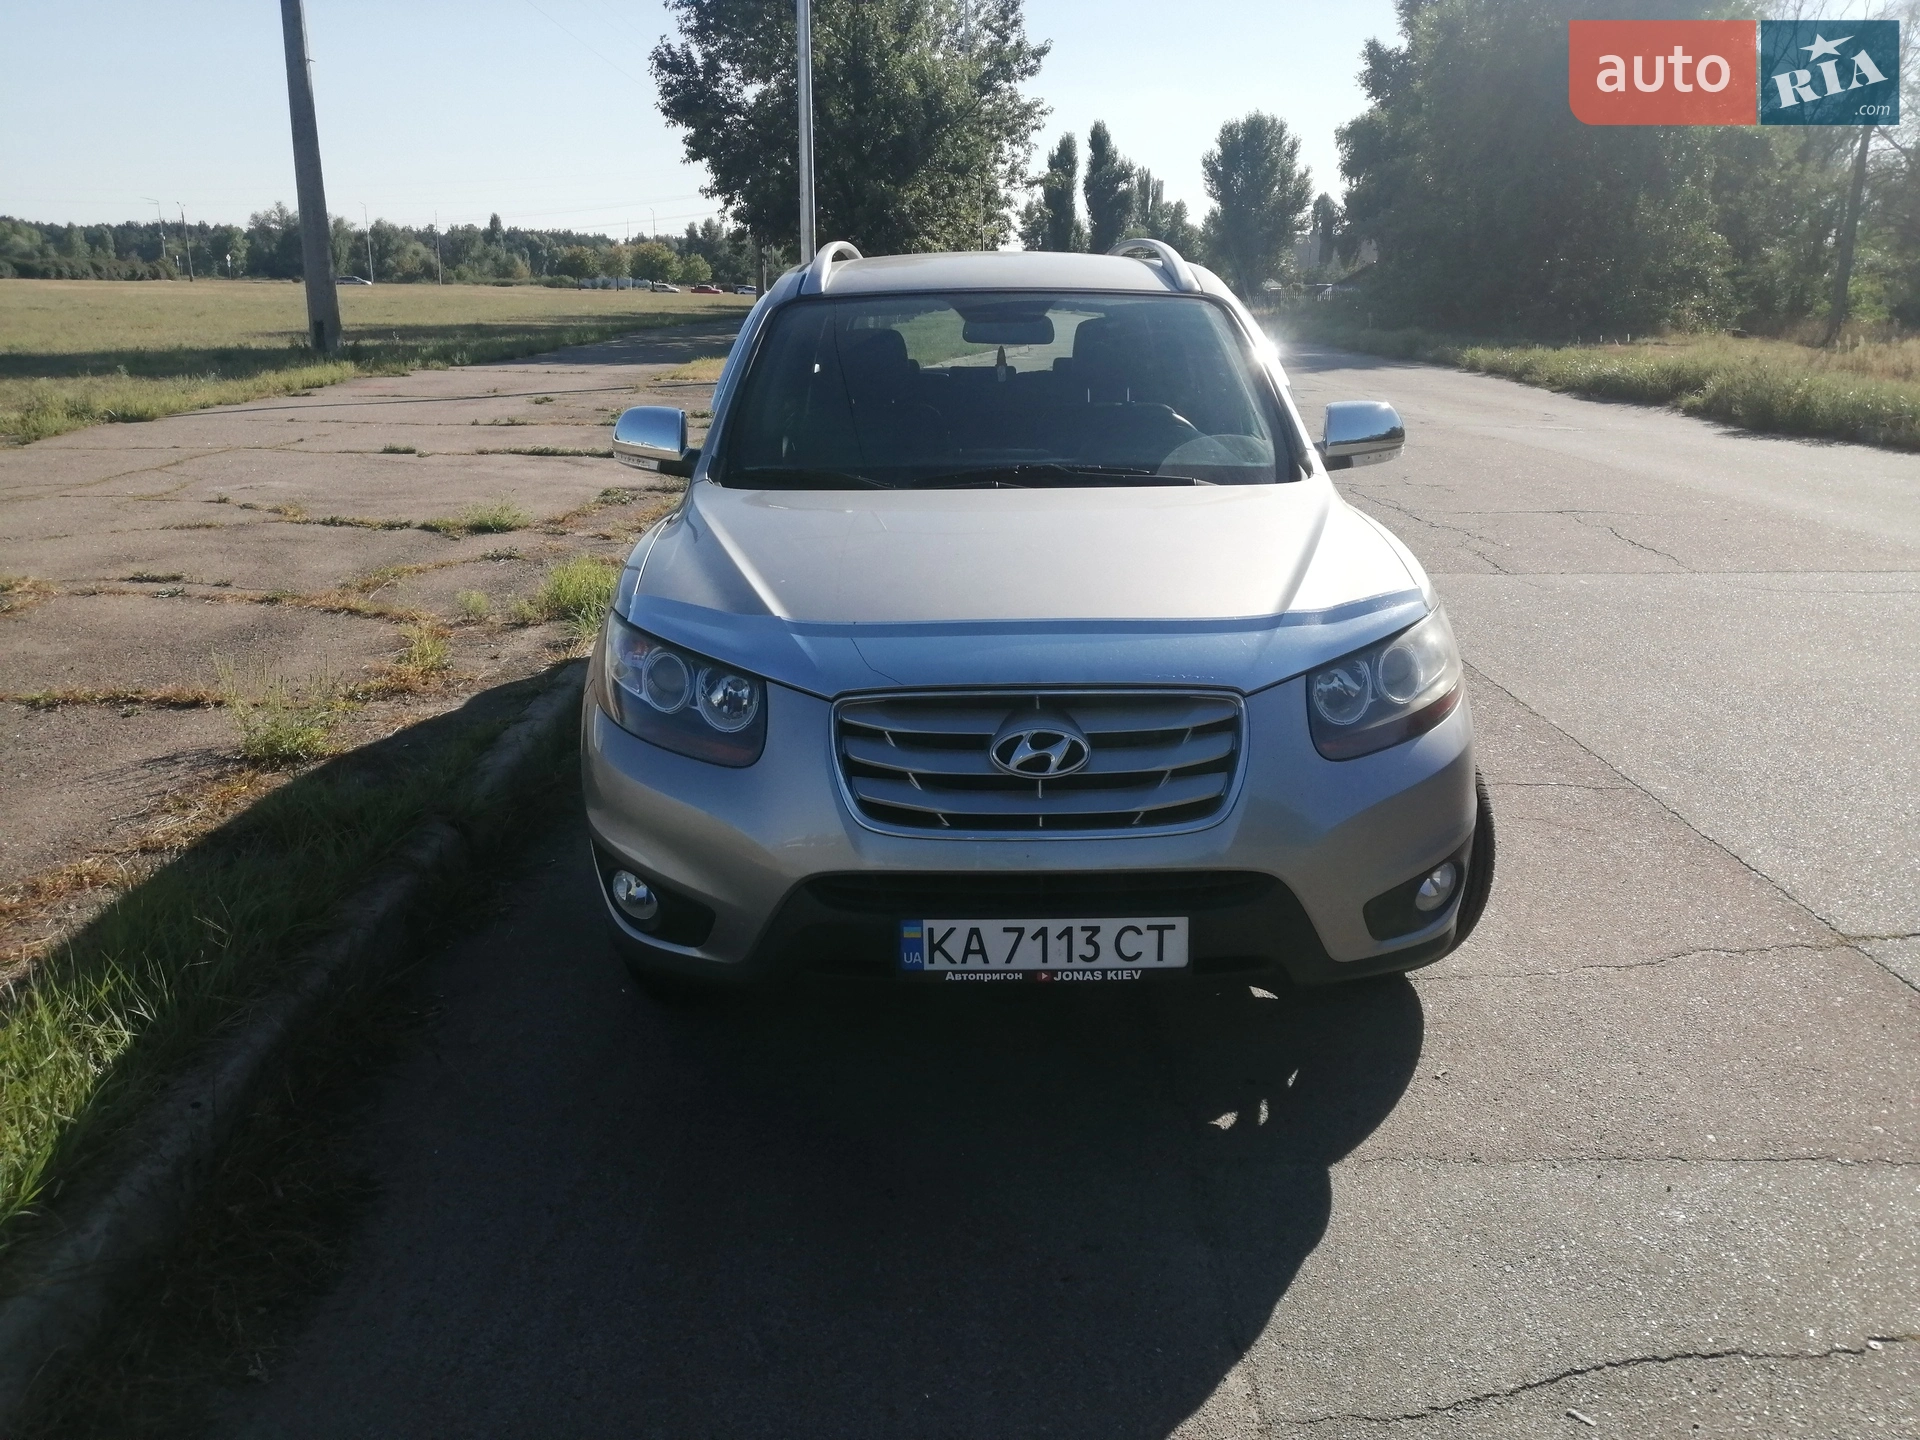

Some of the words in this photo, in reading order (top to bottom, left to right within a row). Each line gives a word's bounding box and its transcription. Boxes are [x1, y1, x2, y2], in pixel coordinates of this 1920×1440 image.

[927, 926, 990, 965] KA
[1002, 925, 1101, 964] 7113
[1114, 924, 1176, 962] CT
[903, 951, 922, 964] UA
[945, 971, 1023, 983] Автопригон
[1053, 970, 1103, 981] JONAS
[1106, 969, 1142, 981] KIEV
